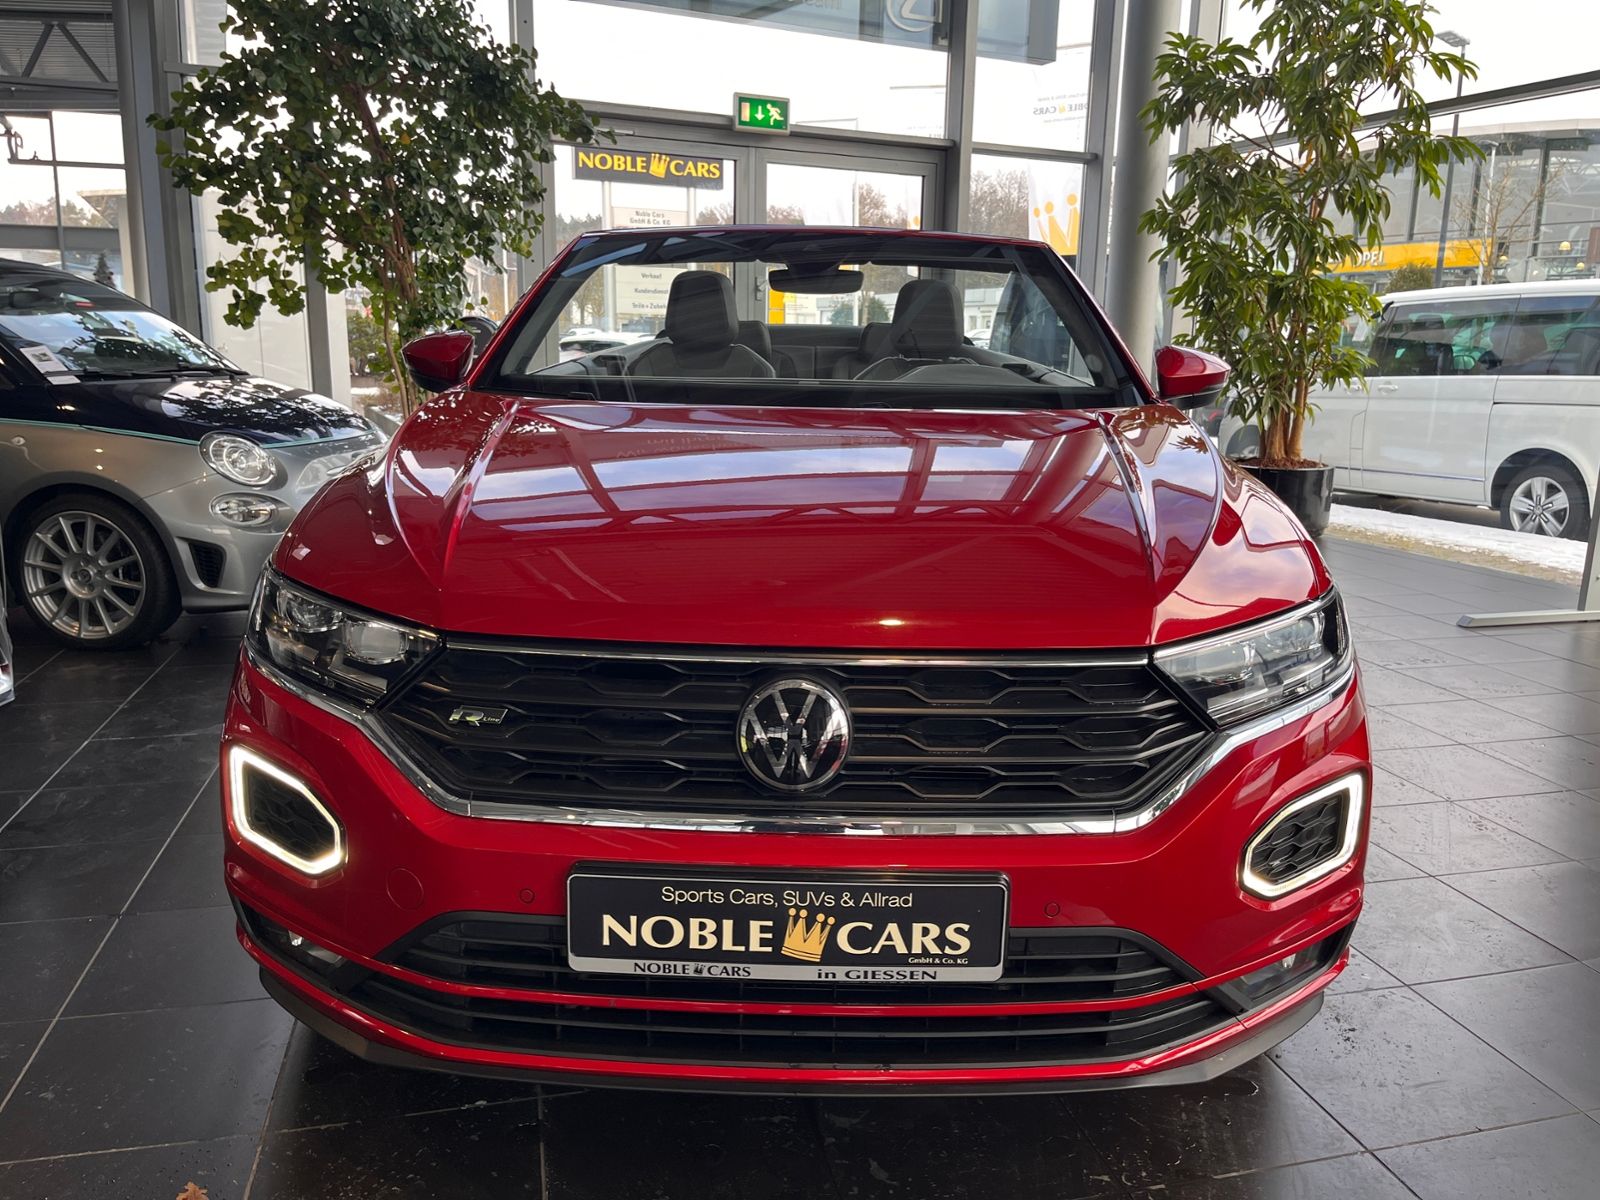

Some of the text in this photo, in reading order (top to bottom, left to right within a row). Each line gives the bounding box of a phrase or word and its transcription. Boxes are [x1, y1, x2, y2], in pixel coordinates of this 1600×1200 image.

[578, 152, 721, 178] NOBLE CARS
[662, 886, 913, 908] Sports Cars, SUVs & Allrad
[602, 914, 971, 955] NOBLE CARS
[633, 962, 751, 977] NOBLE CARS
[817, 968, 937, 980] in GIESSEN
